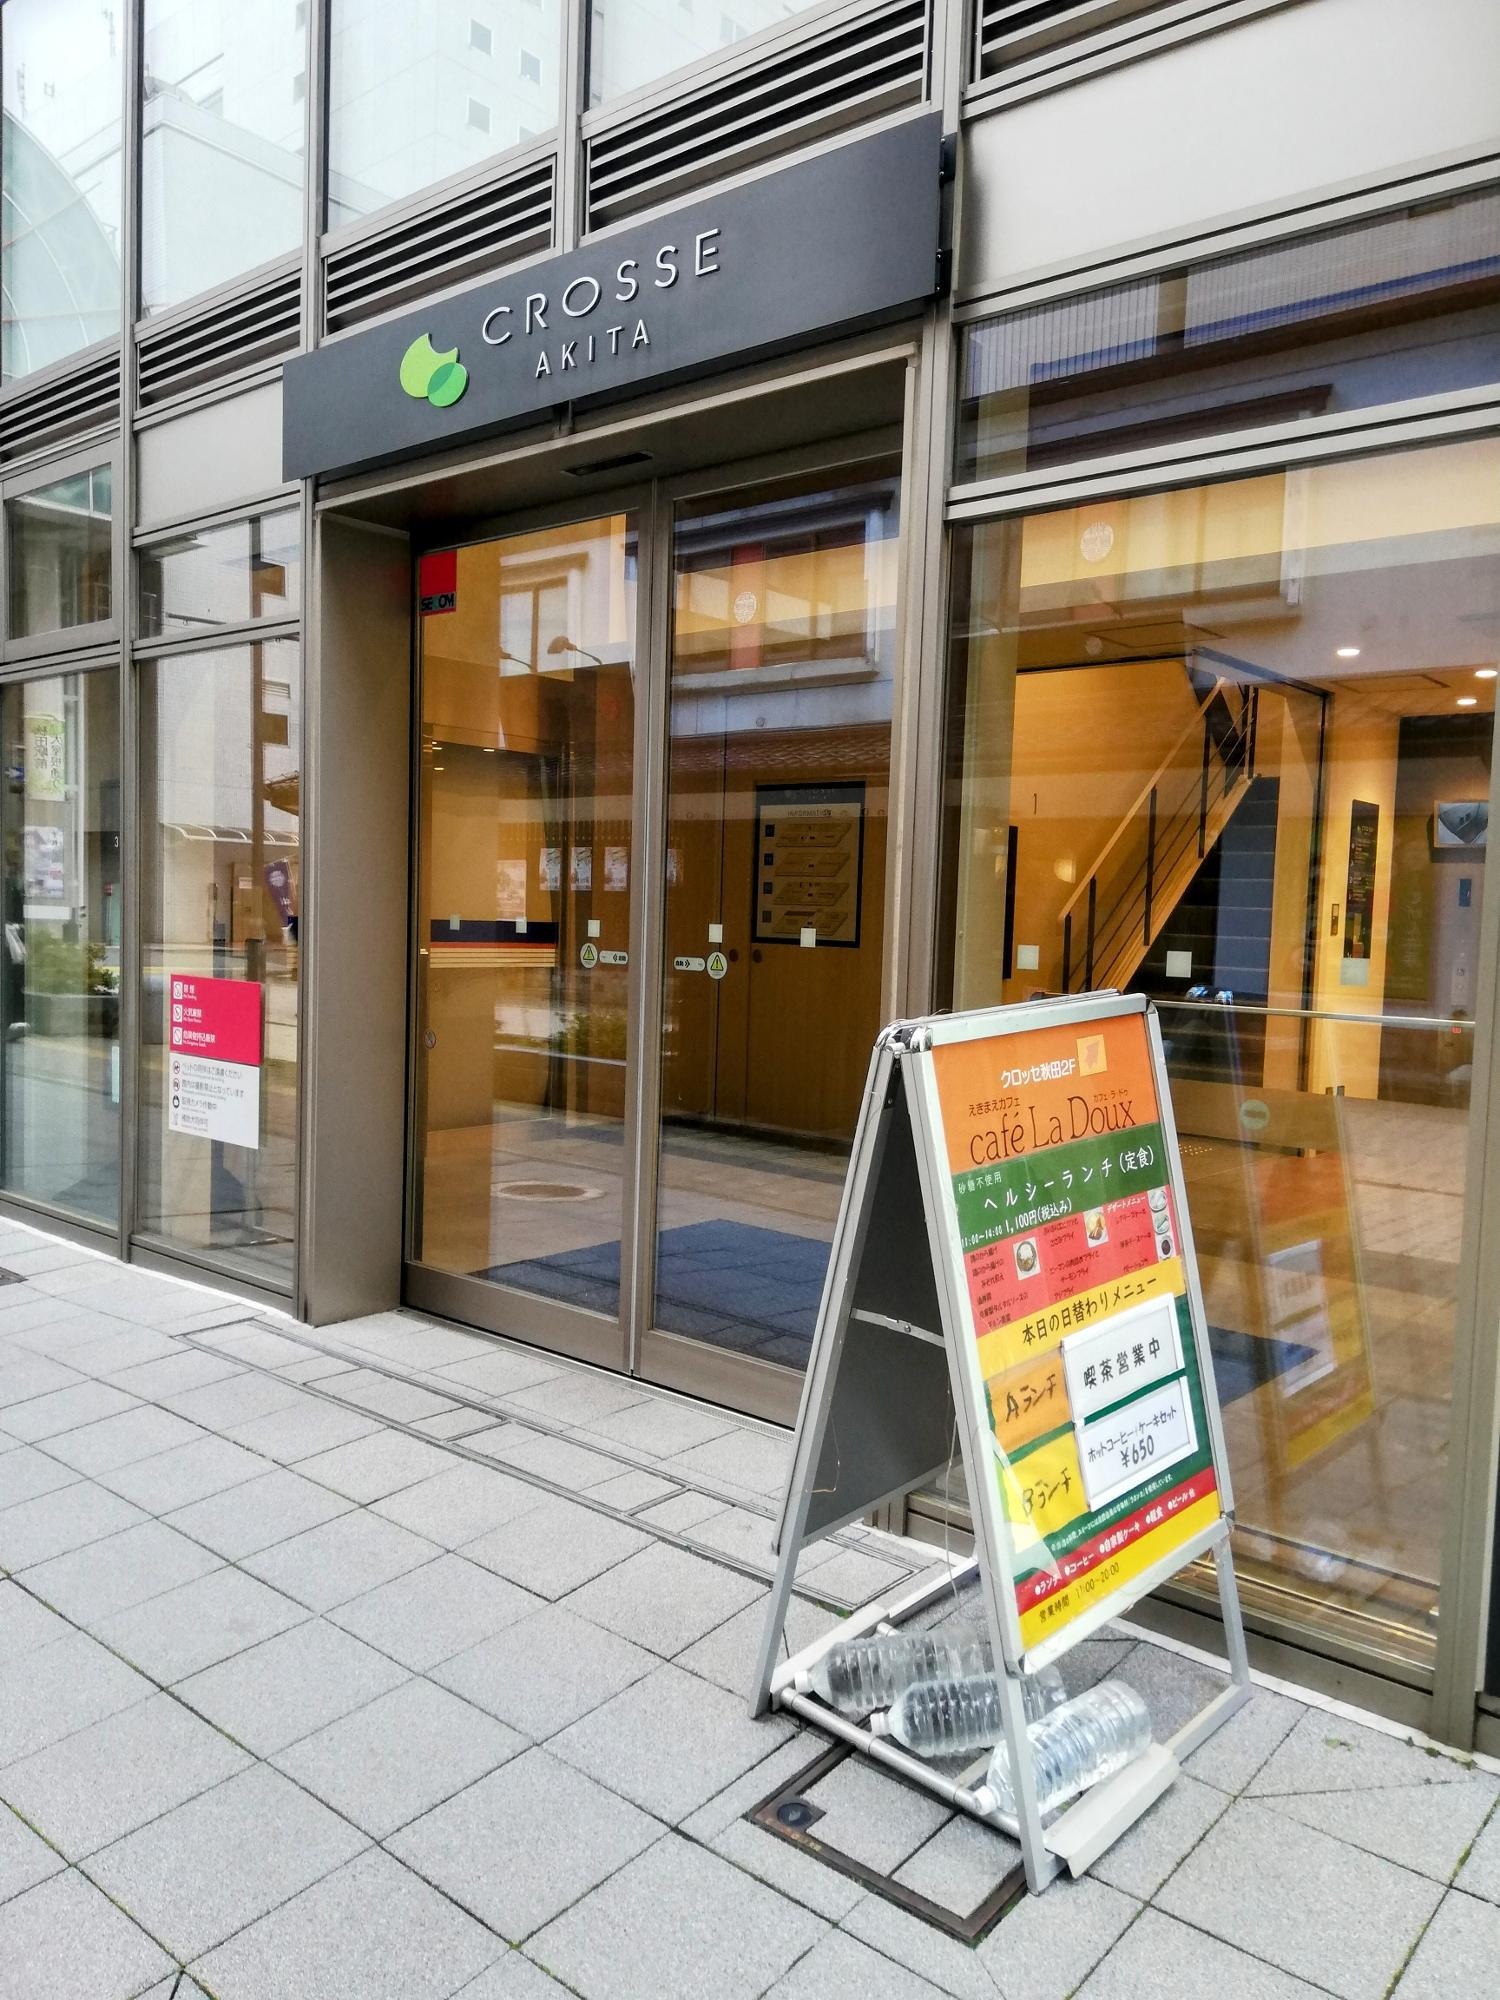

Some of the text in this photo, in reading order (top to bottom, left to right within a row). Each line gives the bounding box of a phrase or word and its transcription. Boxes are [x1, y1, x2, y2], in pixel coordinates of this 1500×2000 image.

[482, 228, 721, 346] CROSSE
[535, 319, 651, 379] AKITA
[421, 593, 455, 611] SEOM
[1001, 1058, 1077, 1089] クロッセ秋田2F
[968, 1096, 1021, 1117] えきまえカフェ
[970, 1095, 1136, 1165] café La Doux
[958, 1171, 1002, 1195] 砂糖不使用
[1022, 1277, 1157, 1346] 本日の日替わりメニュー
[1083, 1337, 1160, 1390] 喫茶営業中
[1120, 1434, 1155, 1468] ¥650
[1039, 1594, 1070, 1623] 営業時間
